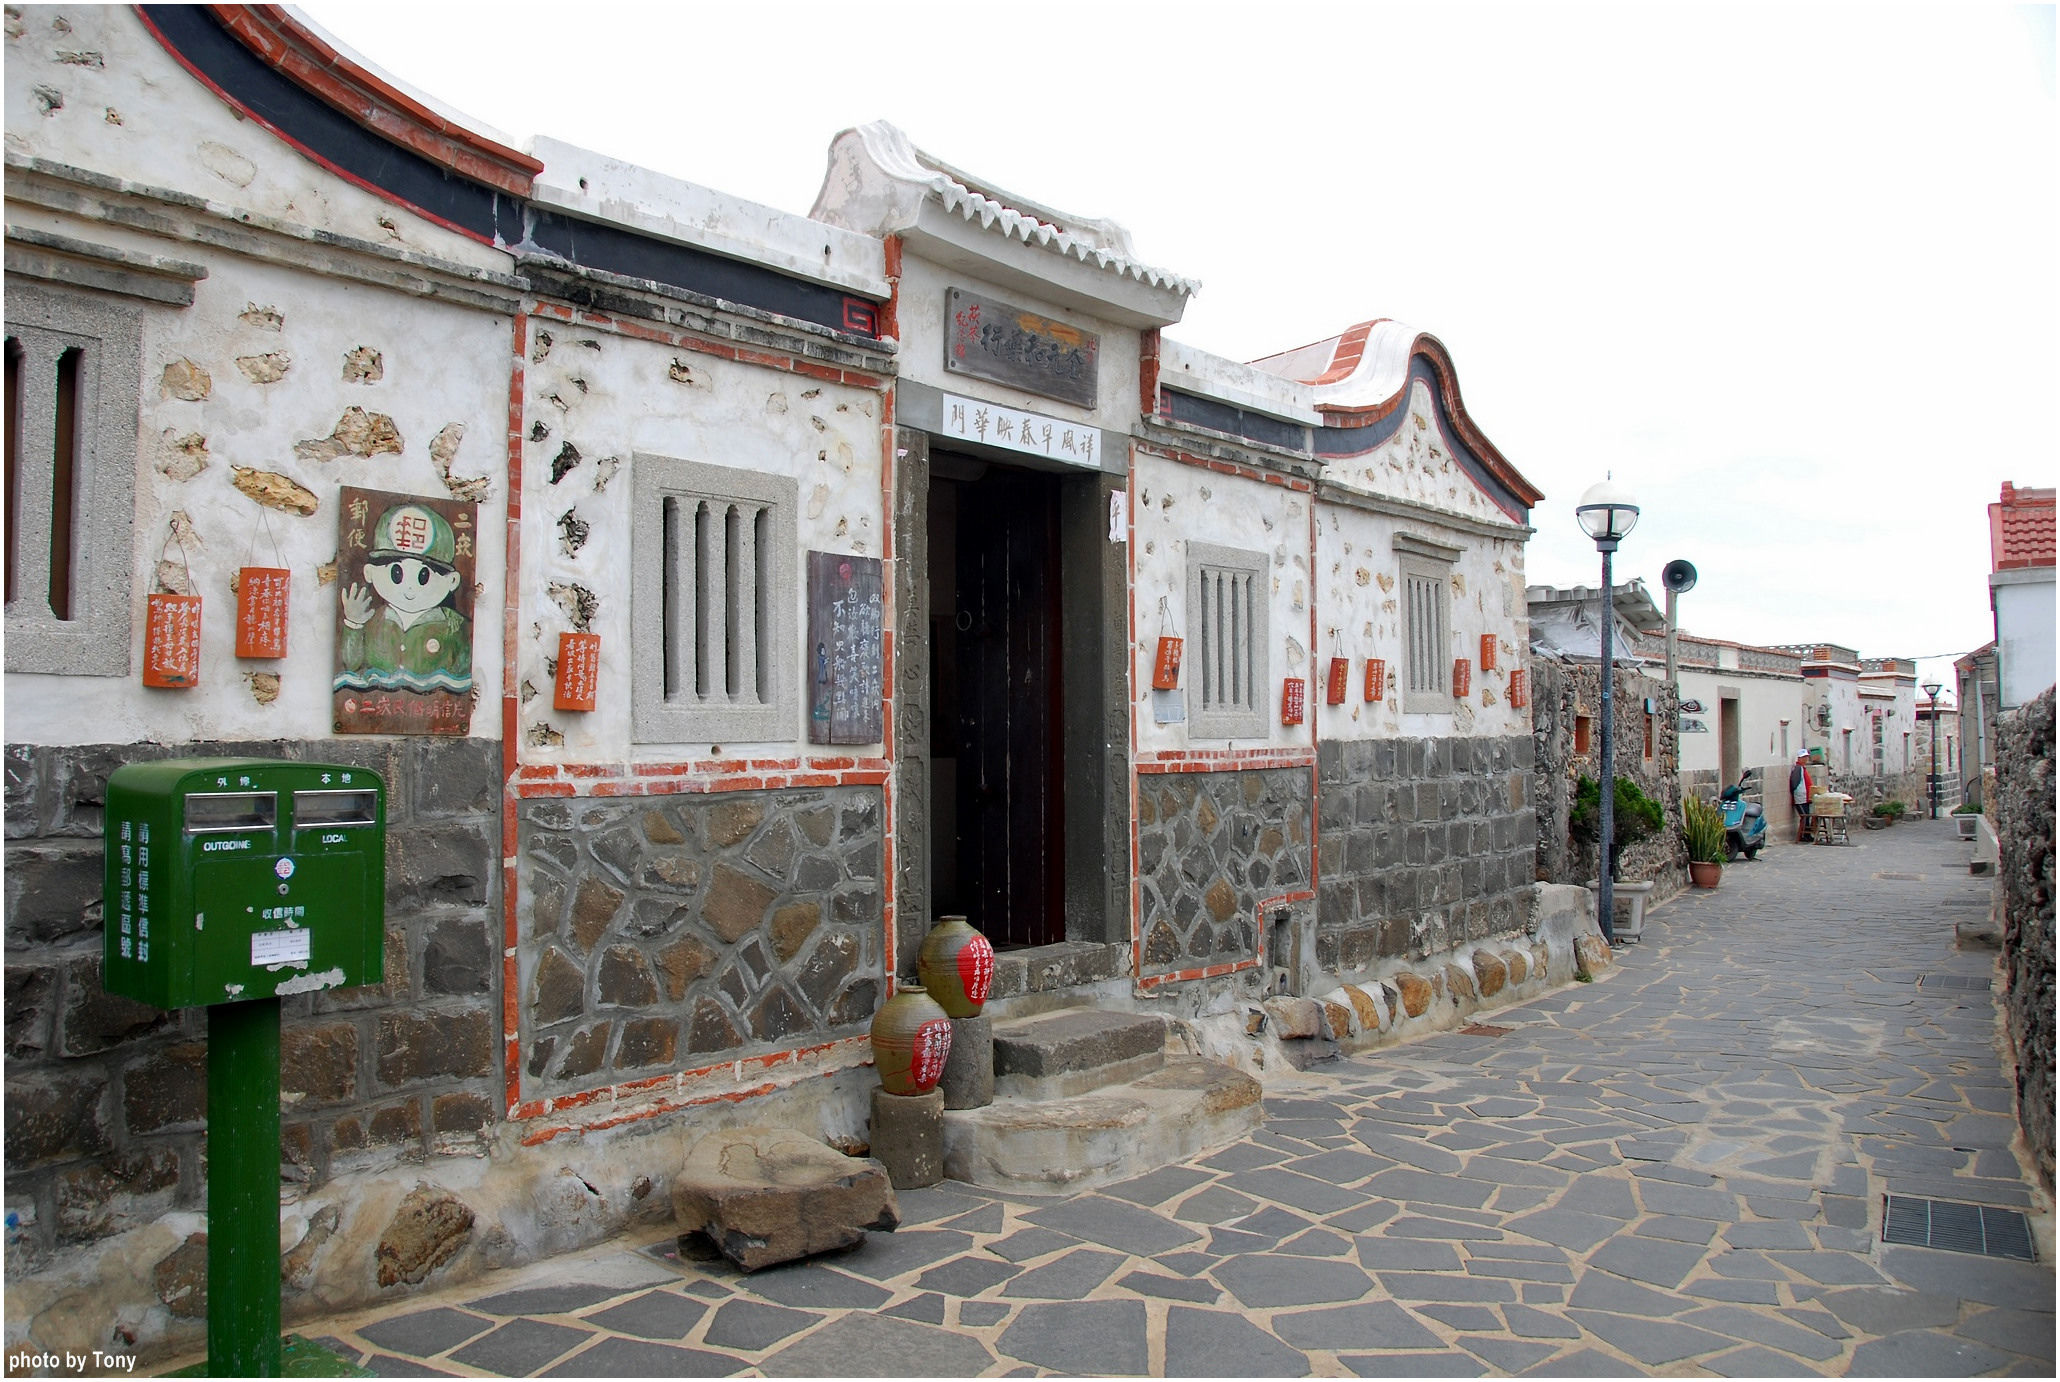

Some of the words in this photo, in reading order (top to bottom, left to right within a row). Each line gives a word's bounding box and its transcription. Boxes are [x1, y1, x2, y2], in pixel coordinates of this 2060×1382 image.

[347, 497, 369, 550] 郵便
[453, 512, 474, 558] 二崁
[321, 773, 352, 784] 本地
[322, 834, 347, 844] LOCAL
